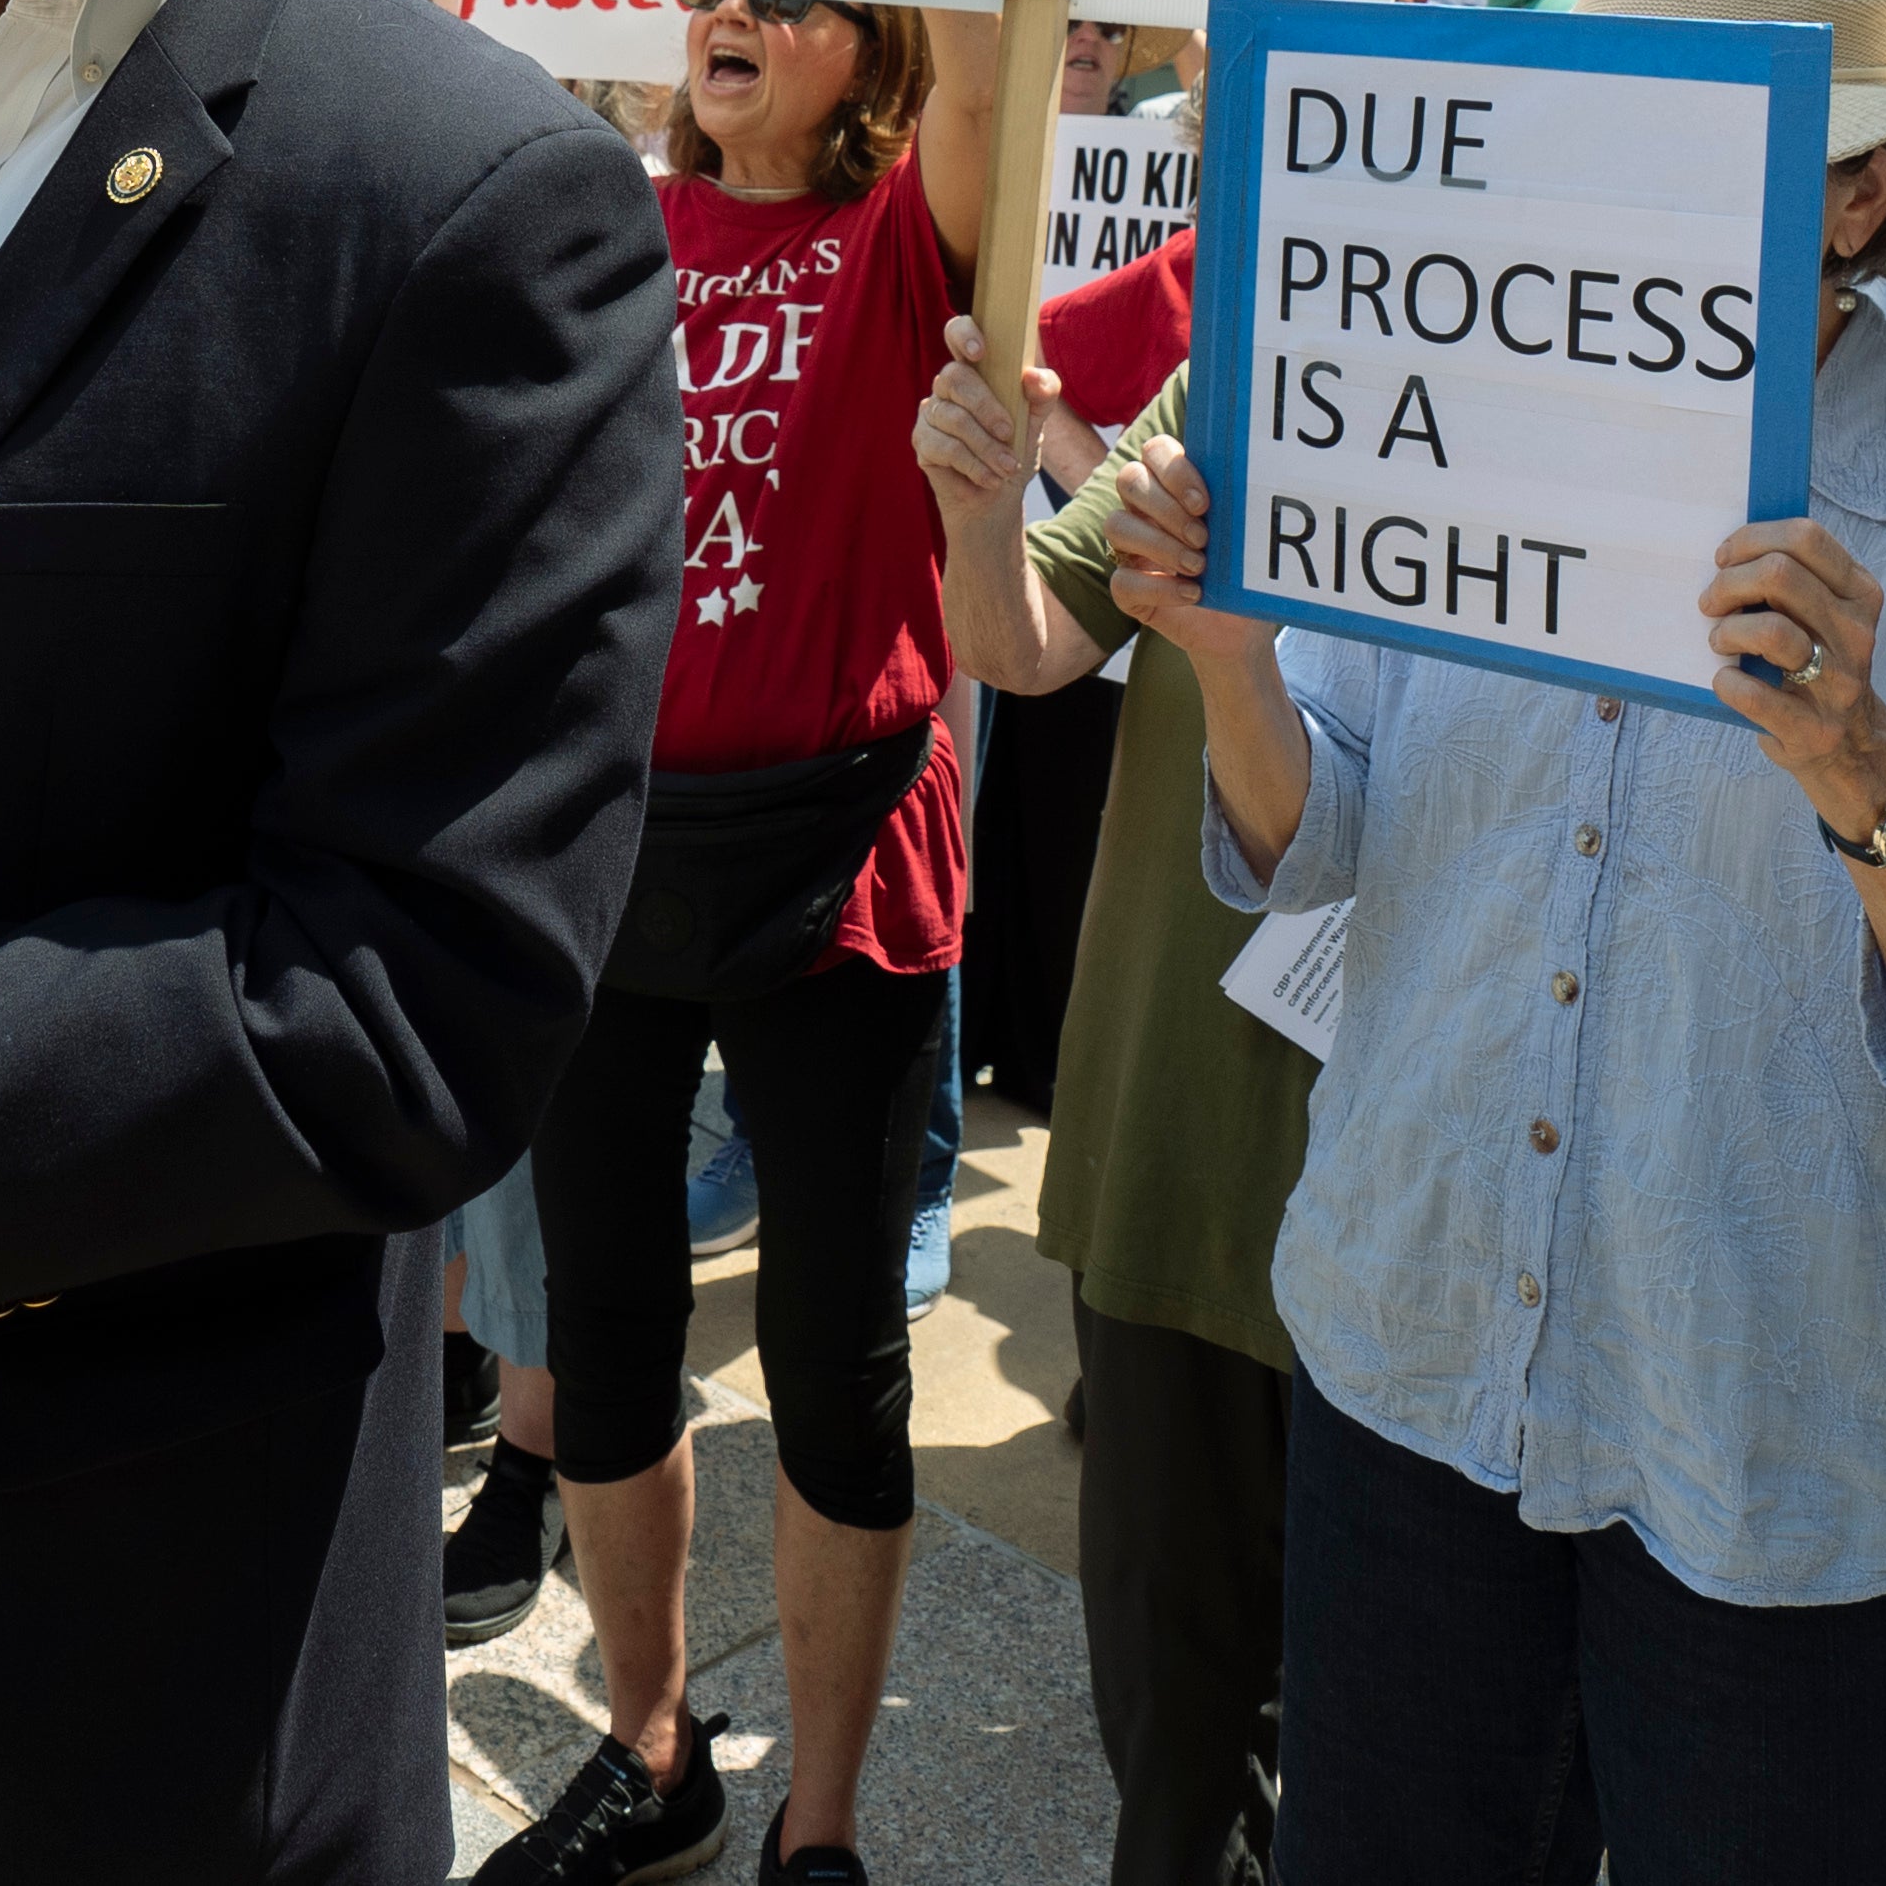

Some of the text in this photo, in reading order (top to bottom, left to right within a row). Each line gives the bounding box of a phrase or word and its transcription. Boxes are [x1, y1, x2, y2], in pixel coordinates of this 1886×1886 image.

[1071, 146, 1129, 205] NO
[1286, 86, 1494, 191] DUE
[1091, 216, 1191, 271] AM
[1278, 235, 1758, 382] PROCESS
[1271, 355, 1450, 469] IS A
[1266, 494, 1588, 636] RIGHT
[1272, 972, 1292, 999] CBP
[1291, 914, 1336, 975] implements
[1287, 956, 1326, 1008] campaign
[1322, 944, 1333, 957] in
